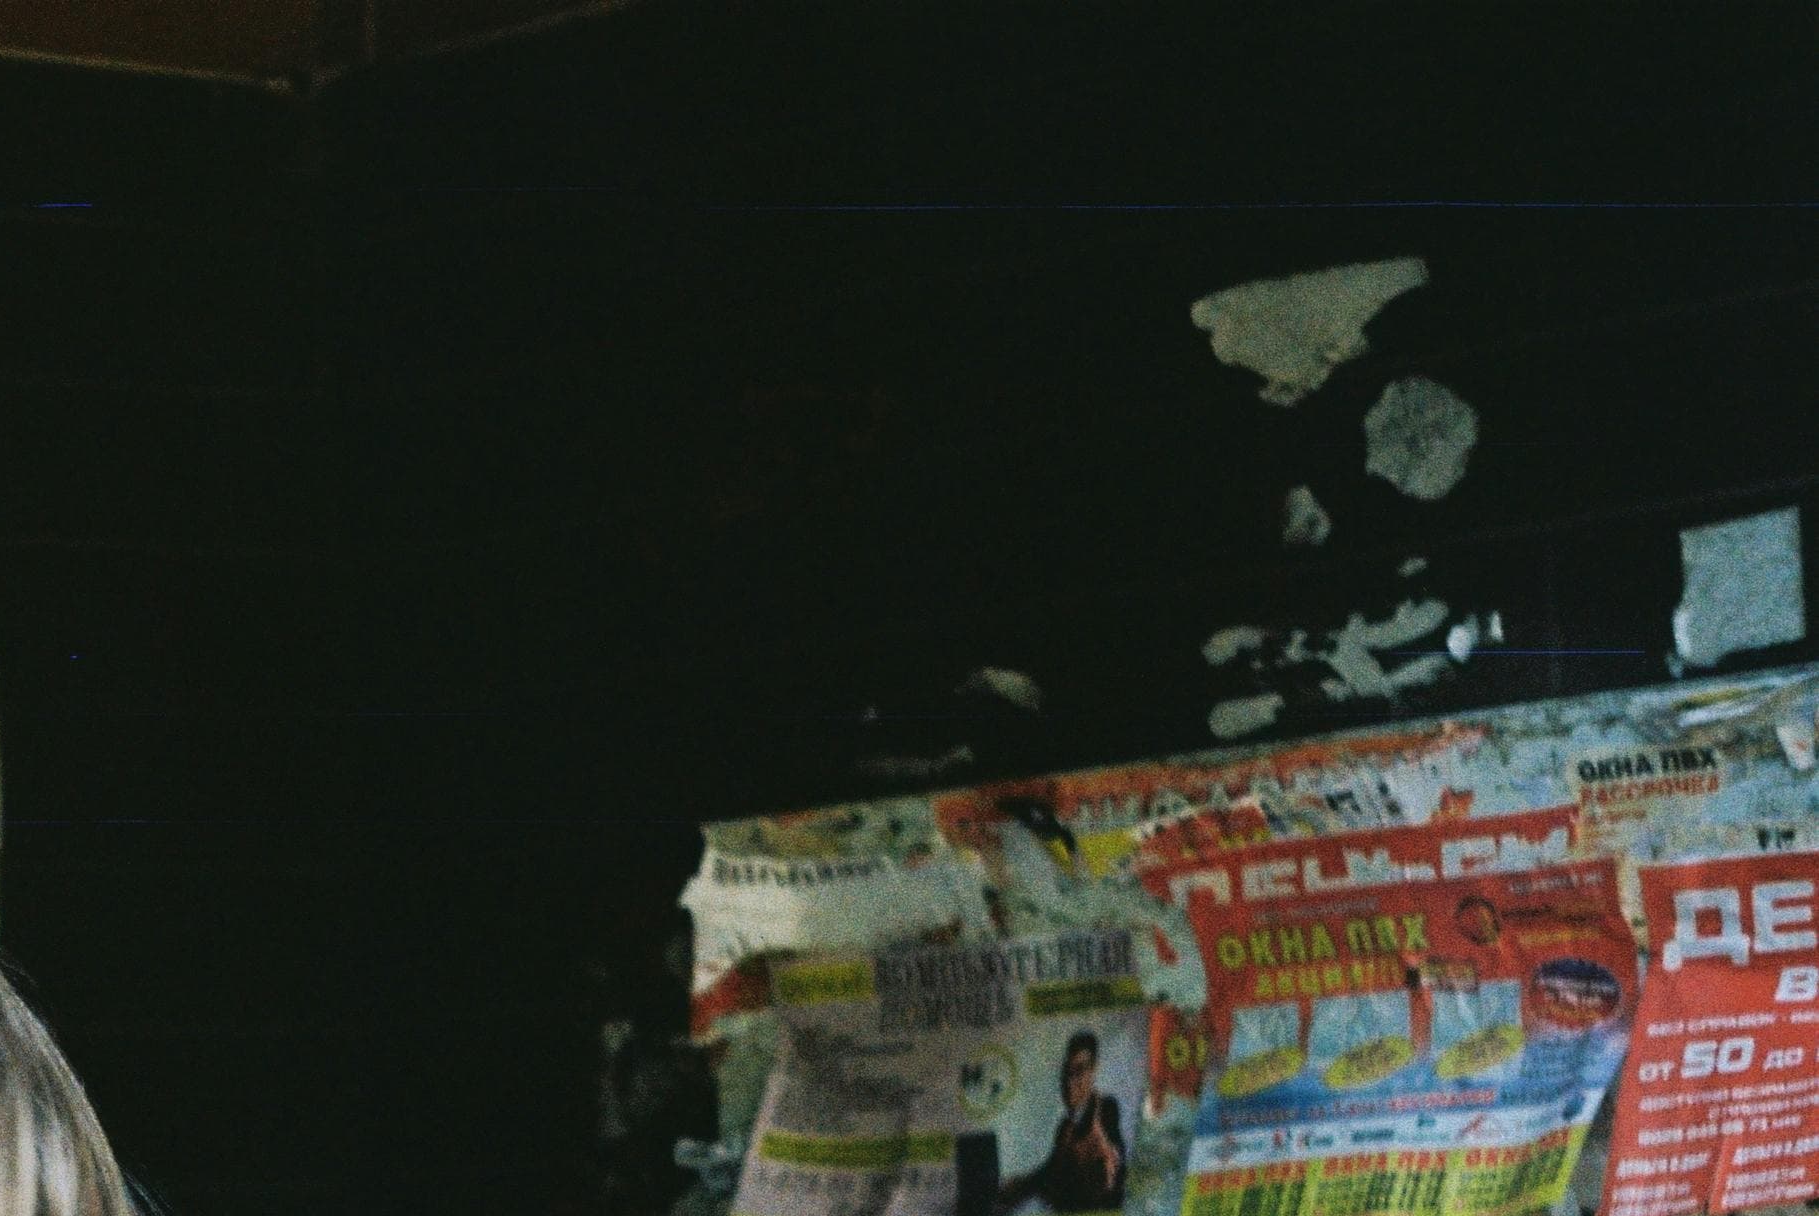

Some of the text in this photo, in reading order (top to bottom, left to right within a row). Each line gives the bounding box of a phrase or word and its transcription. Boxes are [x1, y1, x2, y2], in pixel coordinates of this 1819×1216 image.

[1578, 749, 1720, 783] ОКНА ПВХ
[1580, 775, 1720, 806] РАССРОЧКА
[1217, 913, 1429, 969] ОКНА ПВХ
[1681, 1036, 1756, 1079] 50
[1763, 1047, 1805, 1071] ДО
